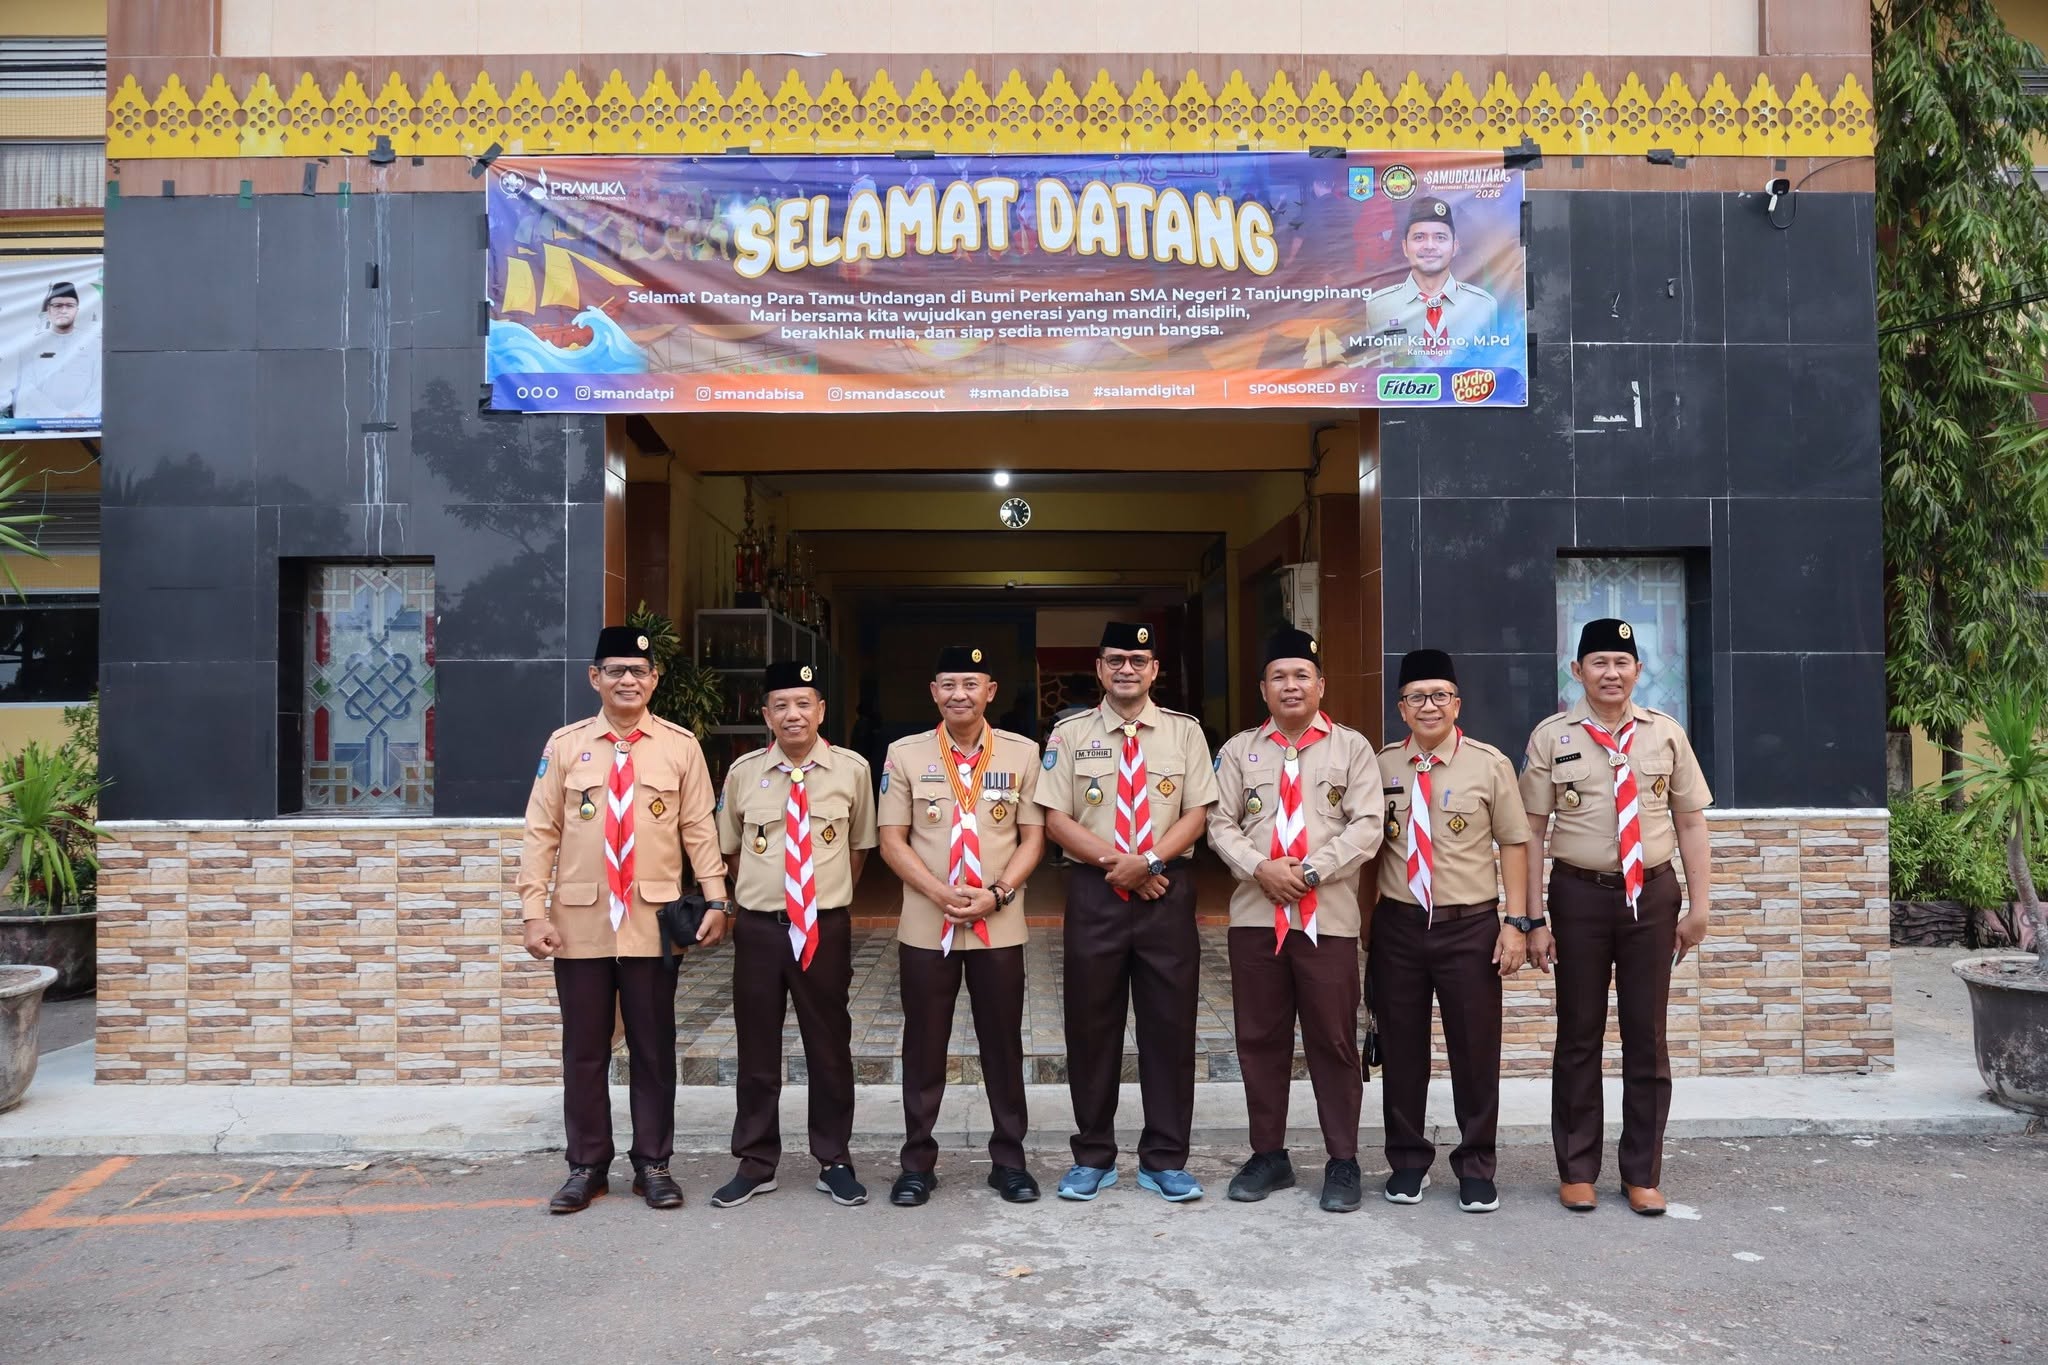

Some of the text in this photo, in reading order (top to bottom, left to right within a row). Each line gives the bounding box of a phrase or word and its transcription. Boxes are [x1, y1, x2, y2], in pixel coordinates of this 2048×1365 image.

[1423, 168, 1511, 184] SAMUDRANTARA
[550, 181, 626, 195] PRAMUKA
[1475, 189, 1501, 198] 2026
[733, 177, 1278, 279] SELAMAT DATANG
[628, 285, 1373, 306] Selamat Datang Para Tamu Undangan di Bumi Perkemahan SMA Negeri 2 Tanjungpinang
[750, 304, 1250, 324] Mari bersama kita wujudkan generasi yang mandiri, disiplin,
[781, 323, 1224, 340] berakhlak mulia, dan siap sedia membangun bangsa.
[1350, 335, 1510, 348] M.Tohir Karjono, M.Pd
[1407, 349, 1453, 357] Kamabigus
[1454, 371, 1492, 389] Hydro
[594, 387, 674, 401] smandatpi
[714, 387, 804, 400] smandabisa
[844, 388, 946, 400] smandascout
[969, 386, 1069, 398] #smandabisa
[1093, 384, 1195, 398] #salamdigital
[1249, 383, 1335, 395] SPONSORED
[1340, 383, 1358, 393] BY
[1384, 380, 1436, 395] Fitbar
[1078, 750, 1108, 758] M.TOHIR
